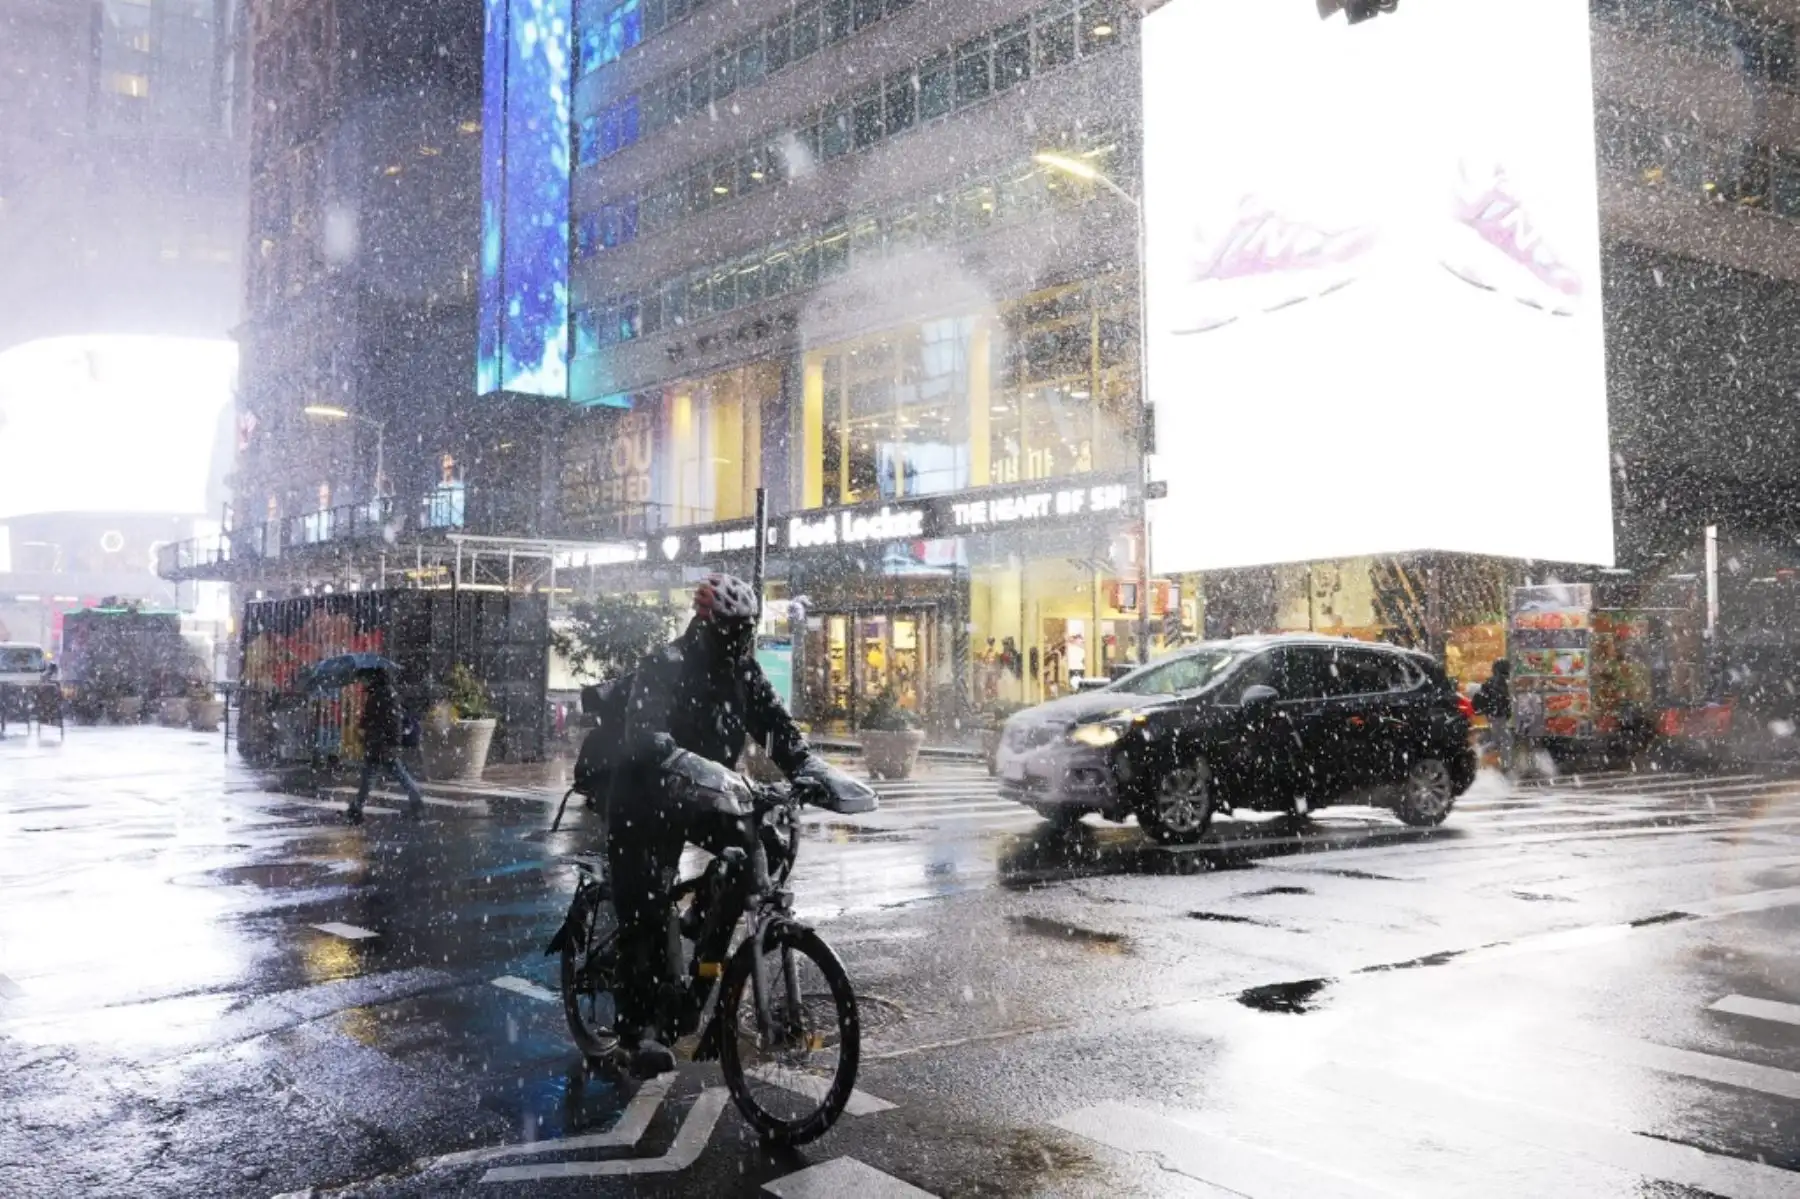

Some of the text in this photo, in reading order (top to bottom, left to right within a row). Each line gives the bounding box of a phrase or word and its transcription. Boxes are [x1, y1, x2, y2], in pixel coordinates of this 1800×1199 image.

[789, 506, 923, 548] Foot Locker
[952, 501, 986, 526] THE
[989, 493, 1052, 521] HEART
